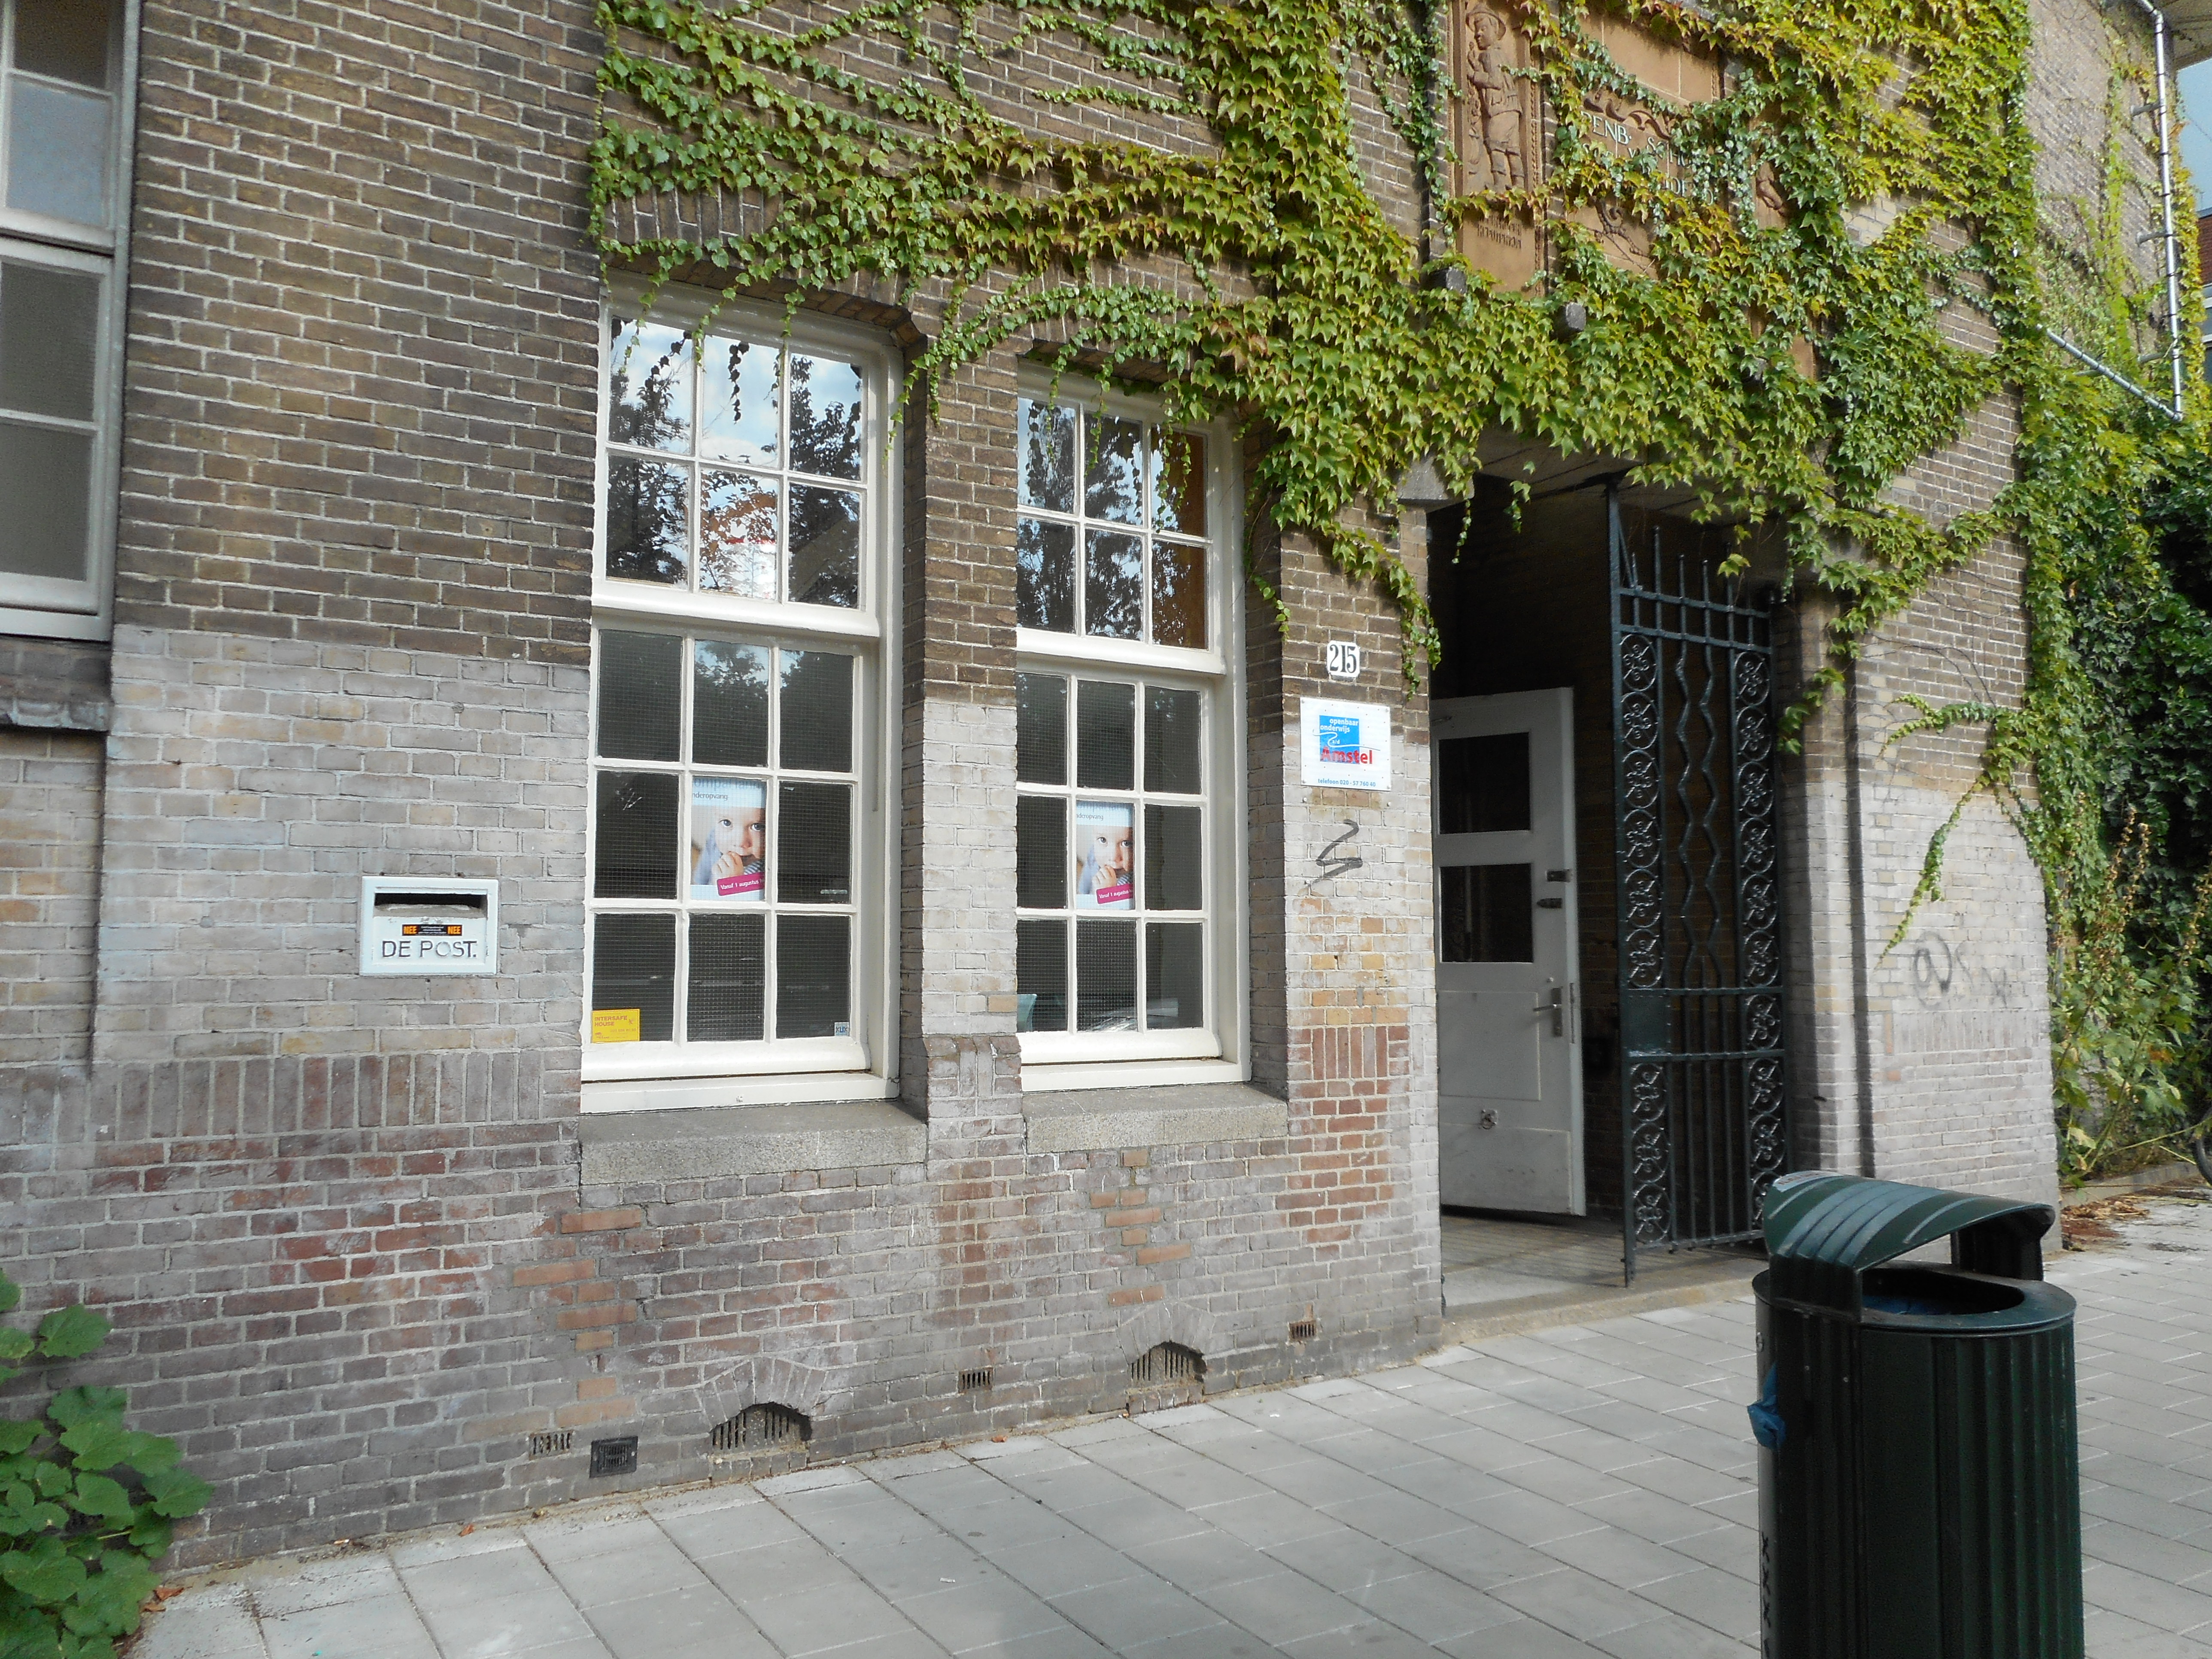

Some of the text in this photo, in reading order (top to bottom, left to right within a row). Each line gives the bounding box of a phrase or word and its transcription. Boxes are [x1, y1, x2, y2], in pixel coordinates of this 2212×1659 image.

[1329, 644, 1357, 674] 215
[1320, 724, 1350, 734] onderwijs
[1320, 746, 1373, 764] Amstel
[404, 926, 417, 934] NEE
[447, 926, 461, 934] NEE
[382, 940, 477, 958] DE POST.
